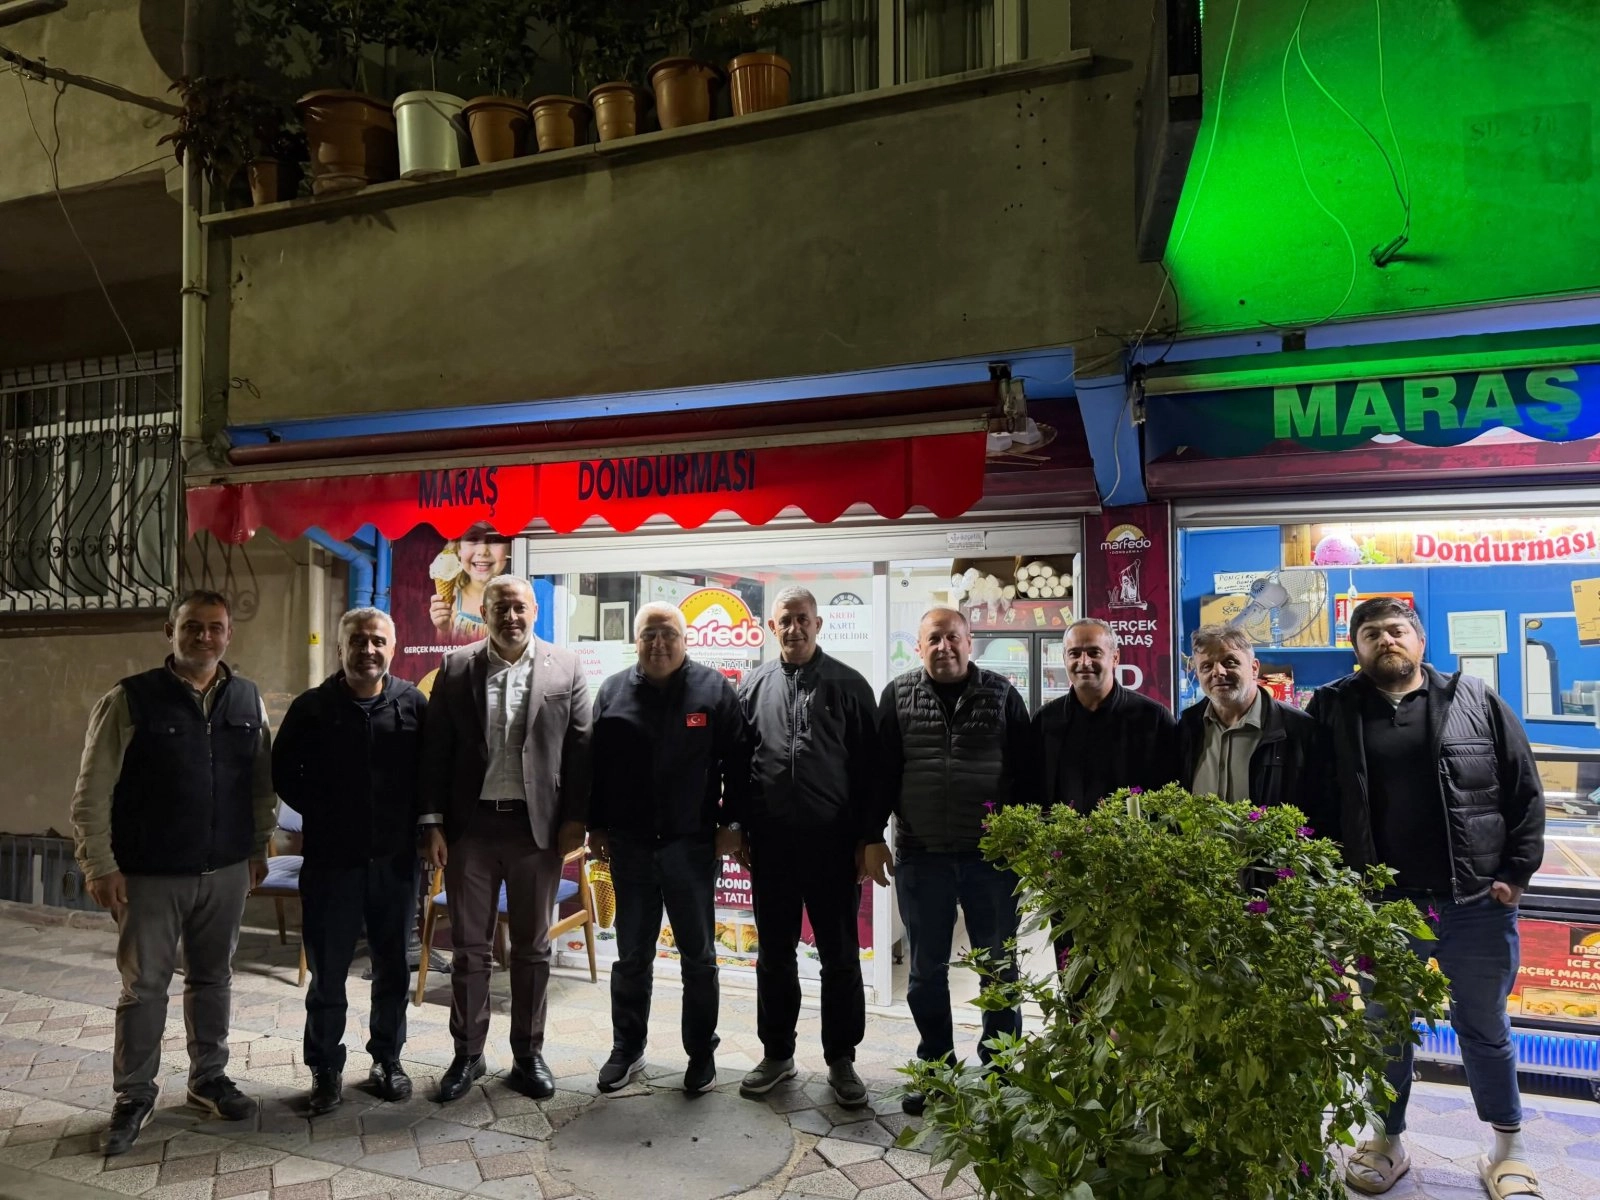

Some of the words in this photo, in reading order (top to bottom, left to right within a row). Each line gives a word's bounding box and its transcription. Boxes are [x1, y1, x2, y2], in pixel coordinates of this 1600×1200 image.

[1273, 365, 1583, 439] MARAŞ
[418, 466, 498, 518] MARAŞ
[578, 449, 756, 500] DONDURMASI
[1100, 536, 1151, 550] marfedo
[1415, 530, 1597, 562] Dondurması
[829, 611, 856, 619] KREDİ
[829, 622, 856, 630] KARTI
[1104, 619, 1158, 633] ERÇEK
[686, 619, 764, 647] arfedo
[1115, 634, 1154, 647] ARAŞ
[404, 646, 424, 655] GERÇEK
[723, 892, 752, 905] TATLI
[1567, 959, 1591, 968] ICE
[1518, 966, 1555, 977] RÇEK
[1557, 969, 1600, 981] MARA
[1550, 978, 1600, 990] BAKLAV
